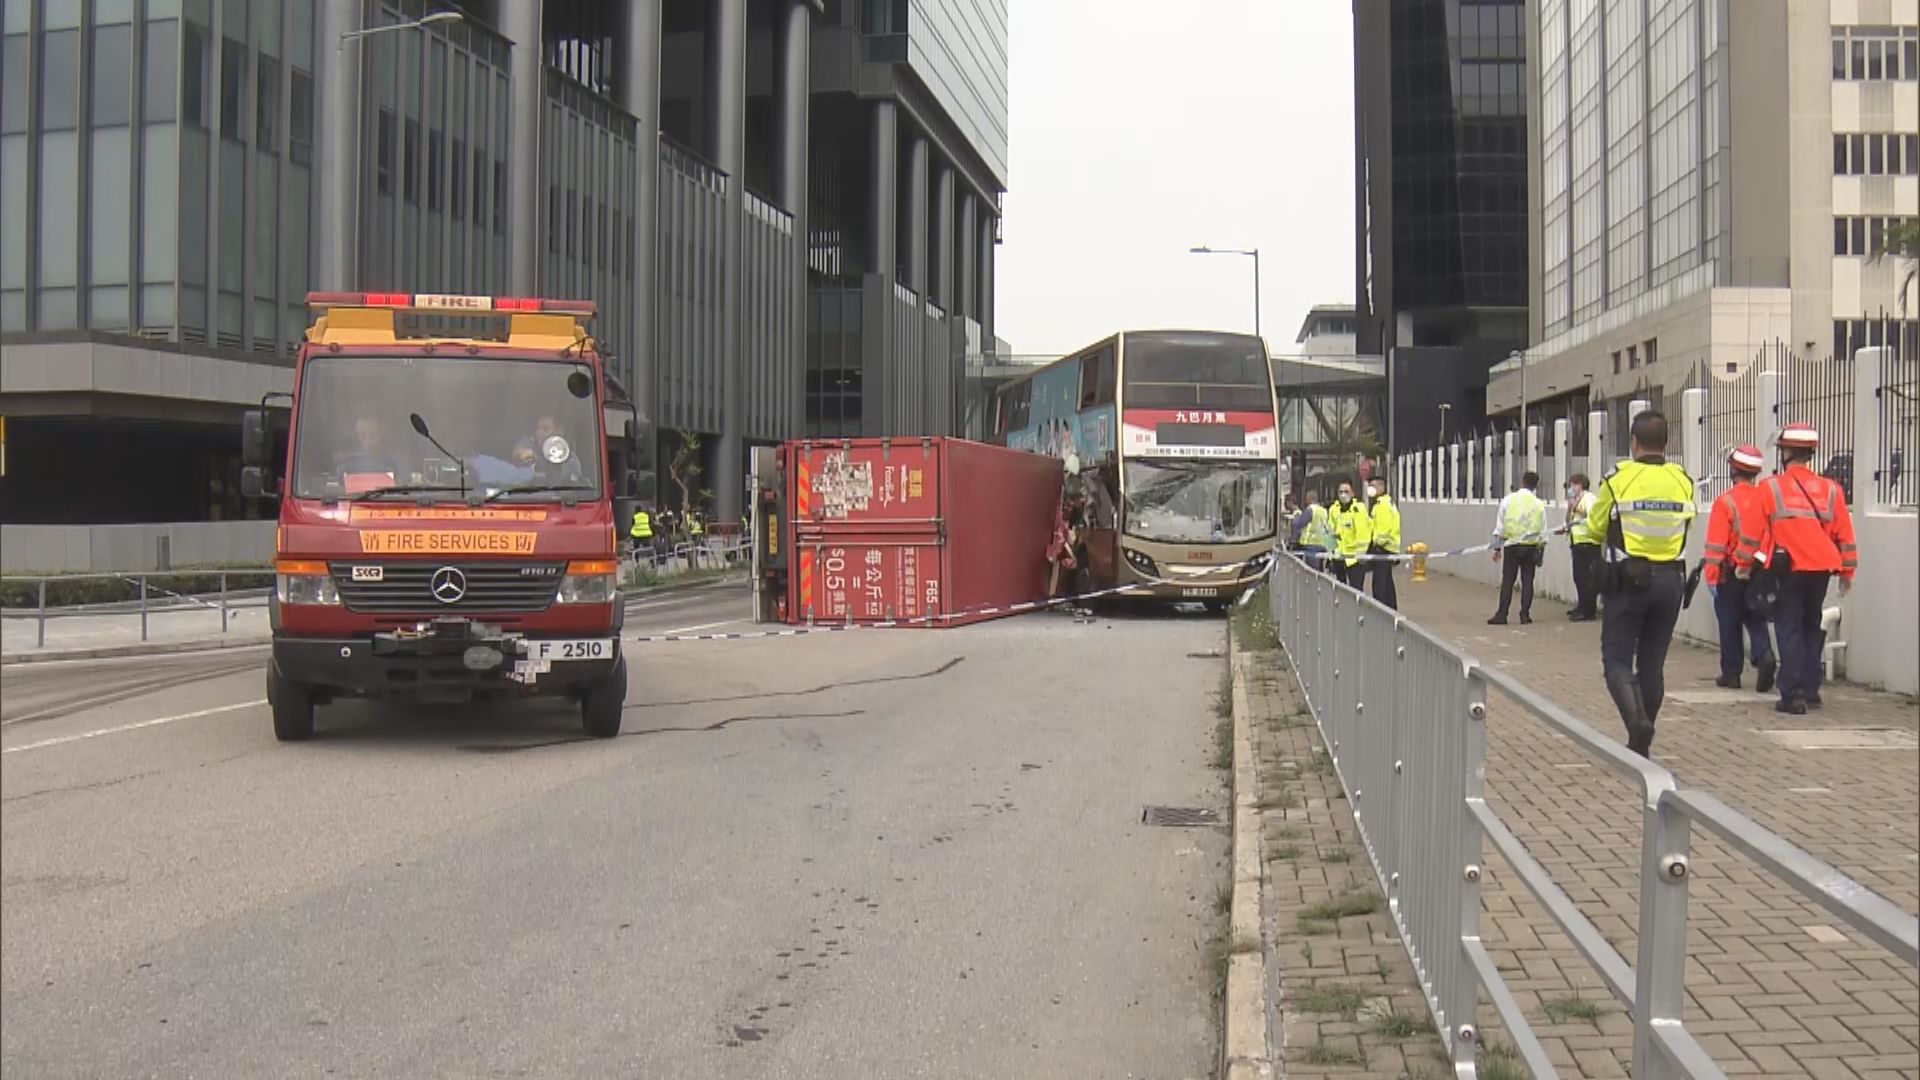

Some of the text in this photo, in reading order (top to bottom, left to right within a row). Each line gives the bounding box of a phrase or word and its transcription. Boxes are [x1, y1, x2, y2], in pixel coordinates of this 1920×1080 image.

[1175, 412, 1226, 423] 九巴月票
[387, 534, 424, 550] FIRE
[429, 534, 509, 550] SERVICES
[864, 549, 882, 600] 每公斤
[926, 580, 938, 604] F65
[540, 642, 602, 658] F 2510
